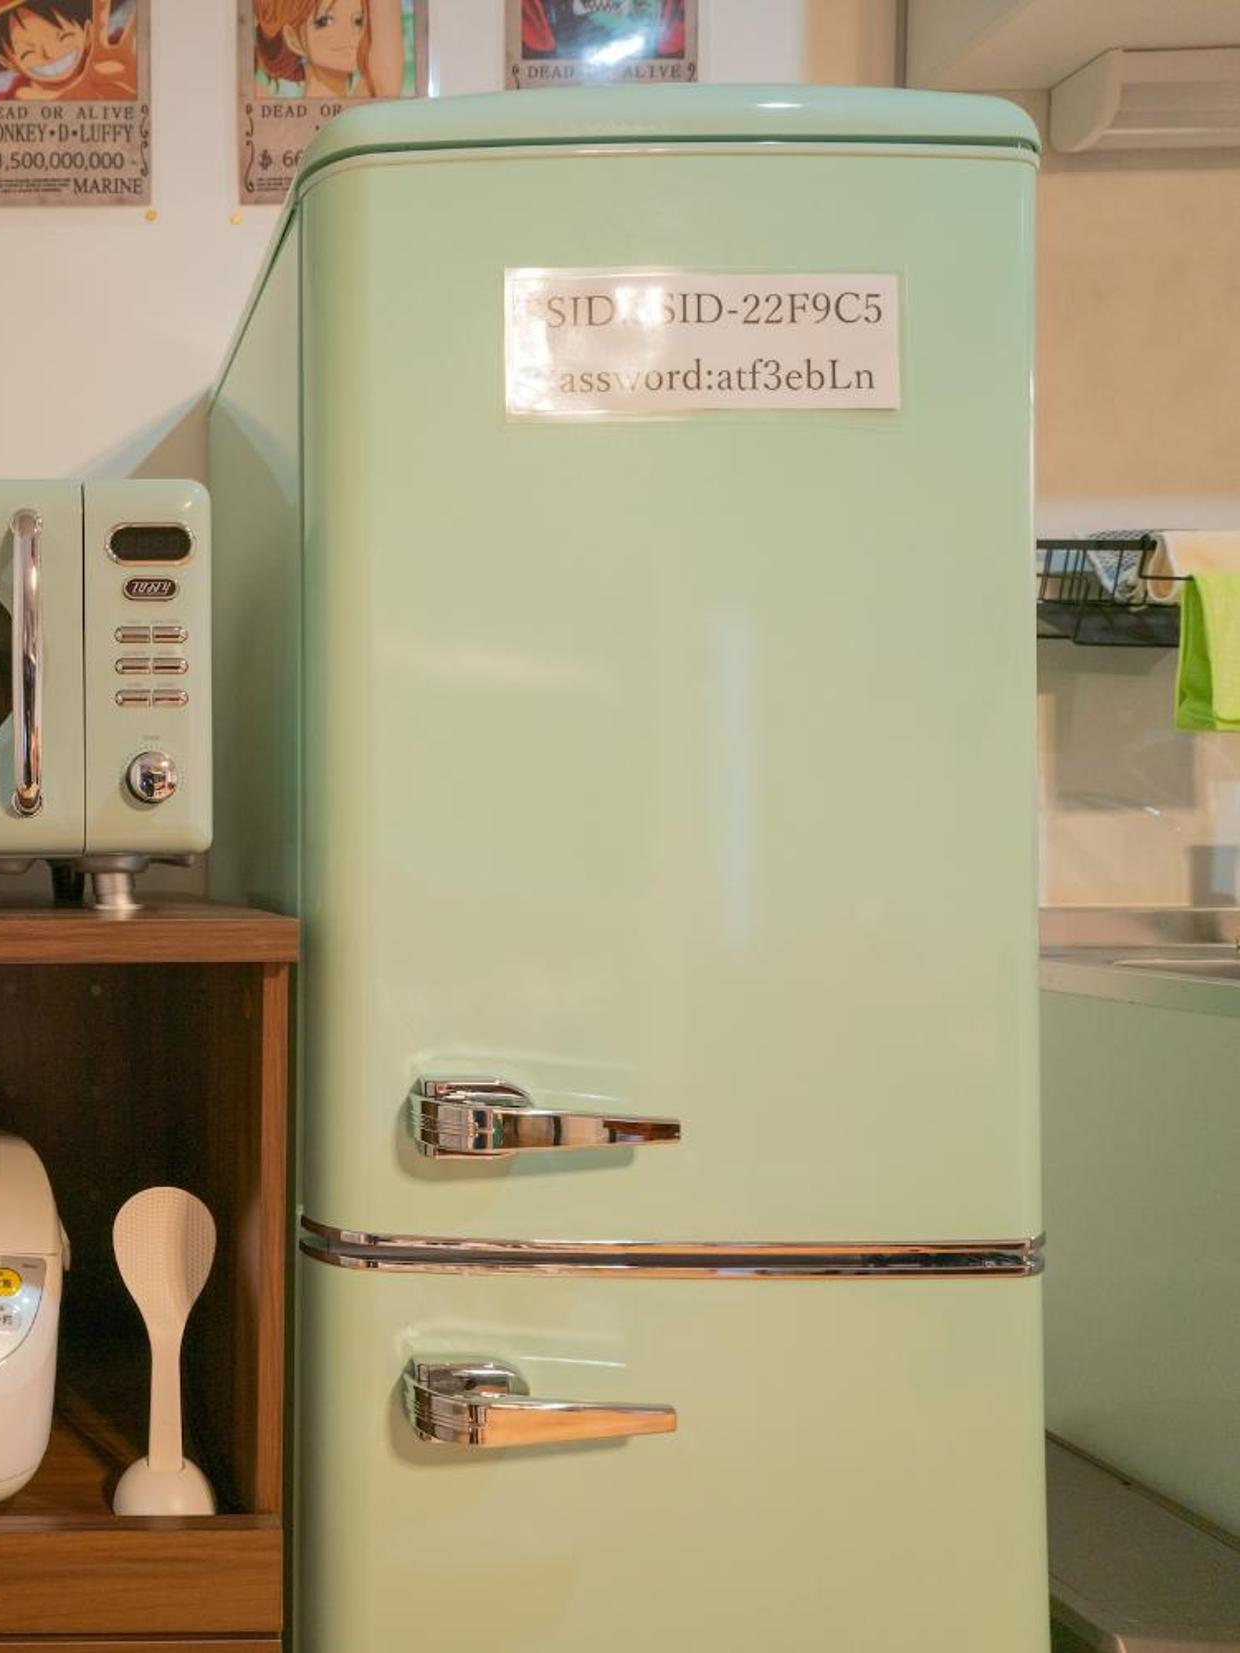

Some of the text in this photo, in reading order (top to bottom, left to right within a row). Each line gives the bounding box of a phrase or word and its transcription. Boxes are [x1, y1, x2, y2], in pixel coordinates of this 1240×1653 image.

[527, 62, 682, 80] DEAD ALIVE
[40, 106, 64, 119] OR
[76, 105, 134, 120] ALIVE
[261, 103, 307, 118] DEAD
[73, 177, 144, 195] MARINE
[559, 358, 876, 395] assword:atf3ebLn
